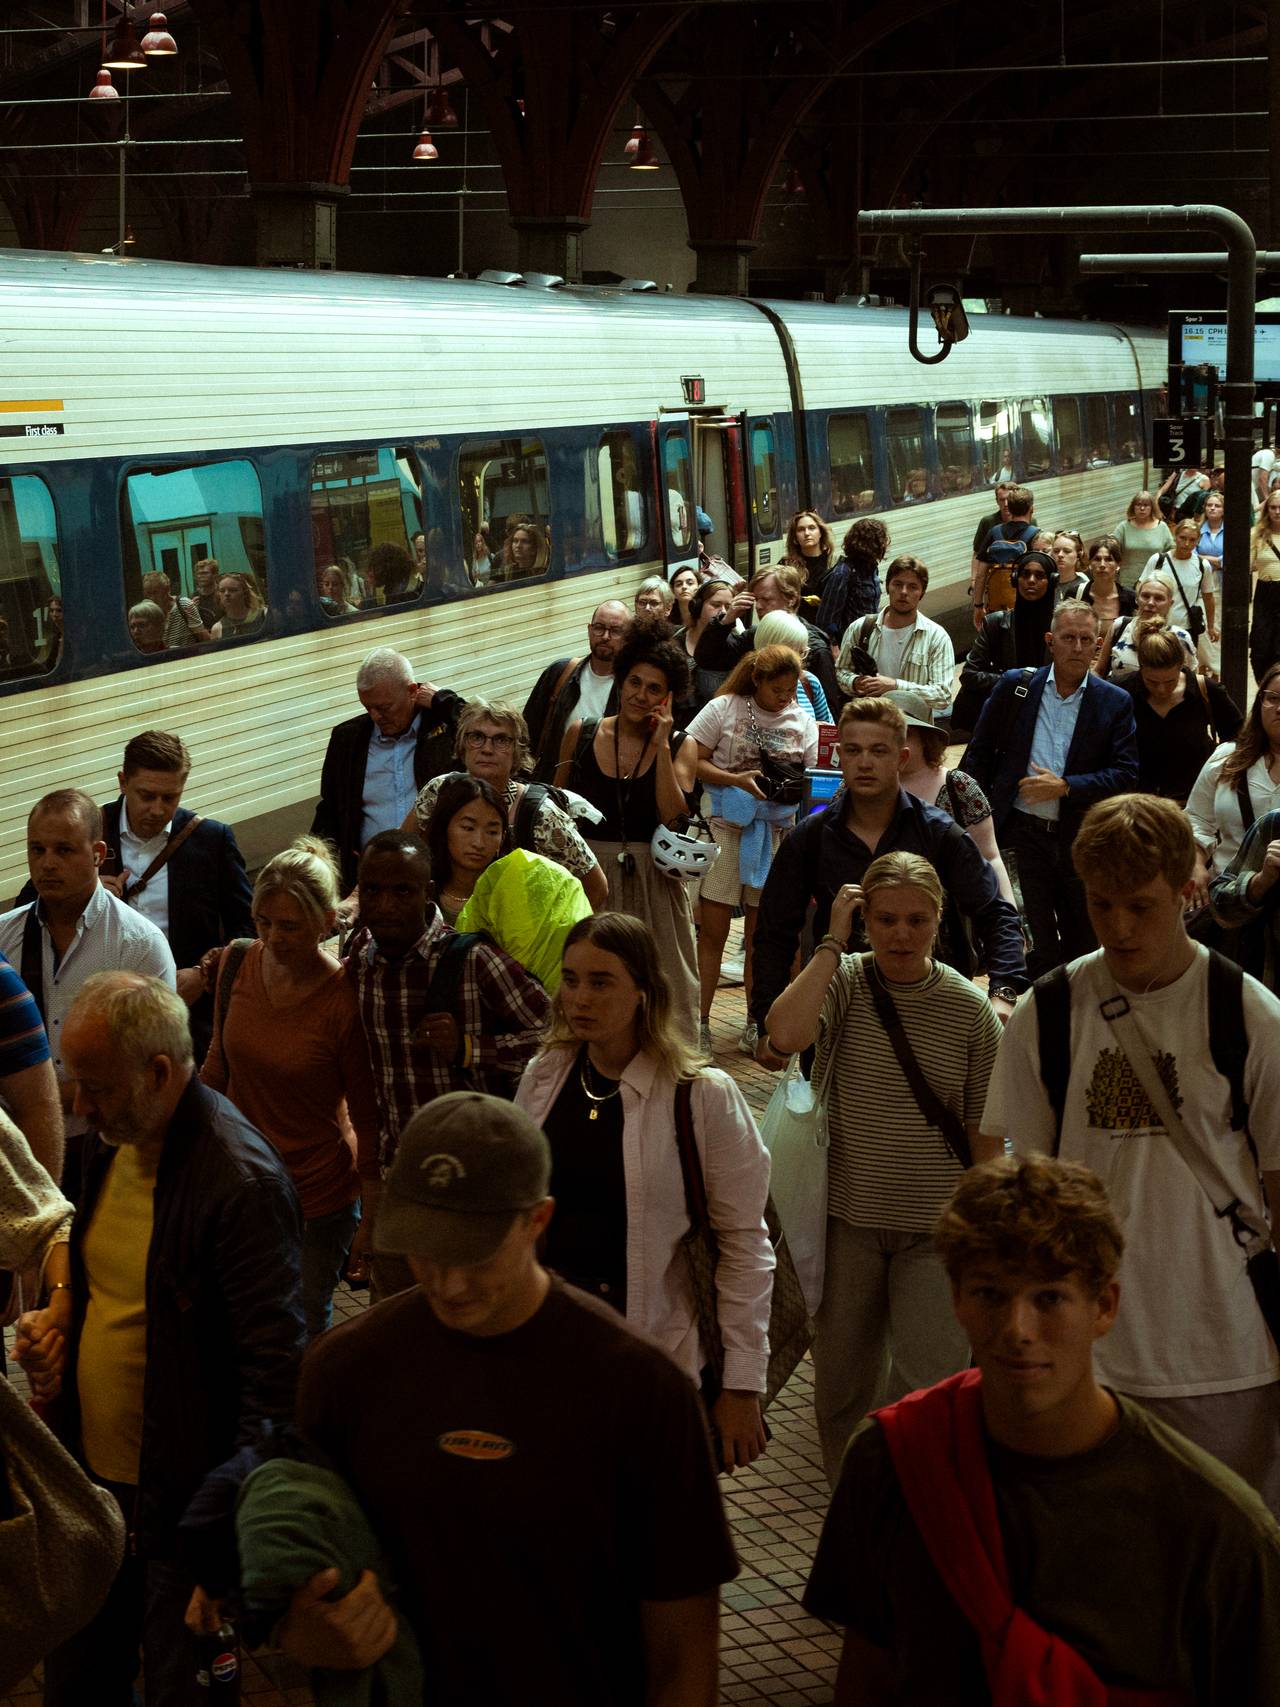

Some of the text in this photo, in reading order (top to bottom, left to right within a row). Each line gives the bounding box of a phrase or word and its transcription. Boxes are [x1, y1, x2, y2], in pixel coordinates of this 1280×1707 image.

[25, 426, 41, 437] First
[41, 424, 57, 436] class
[1168, 438, 1186, 462] 3
